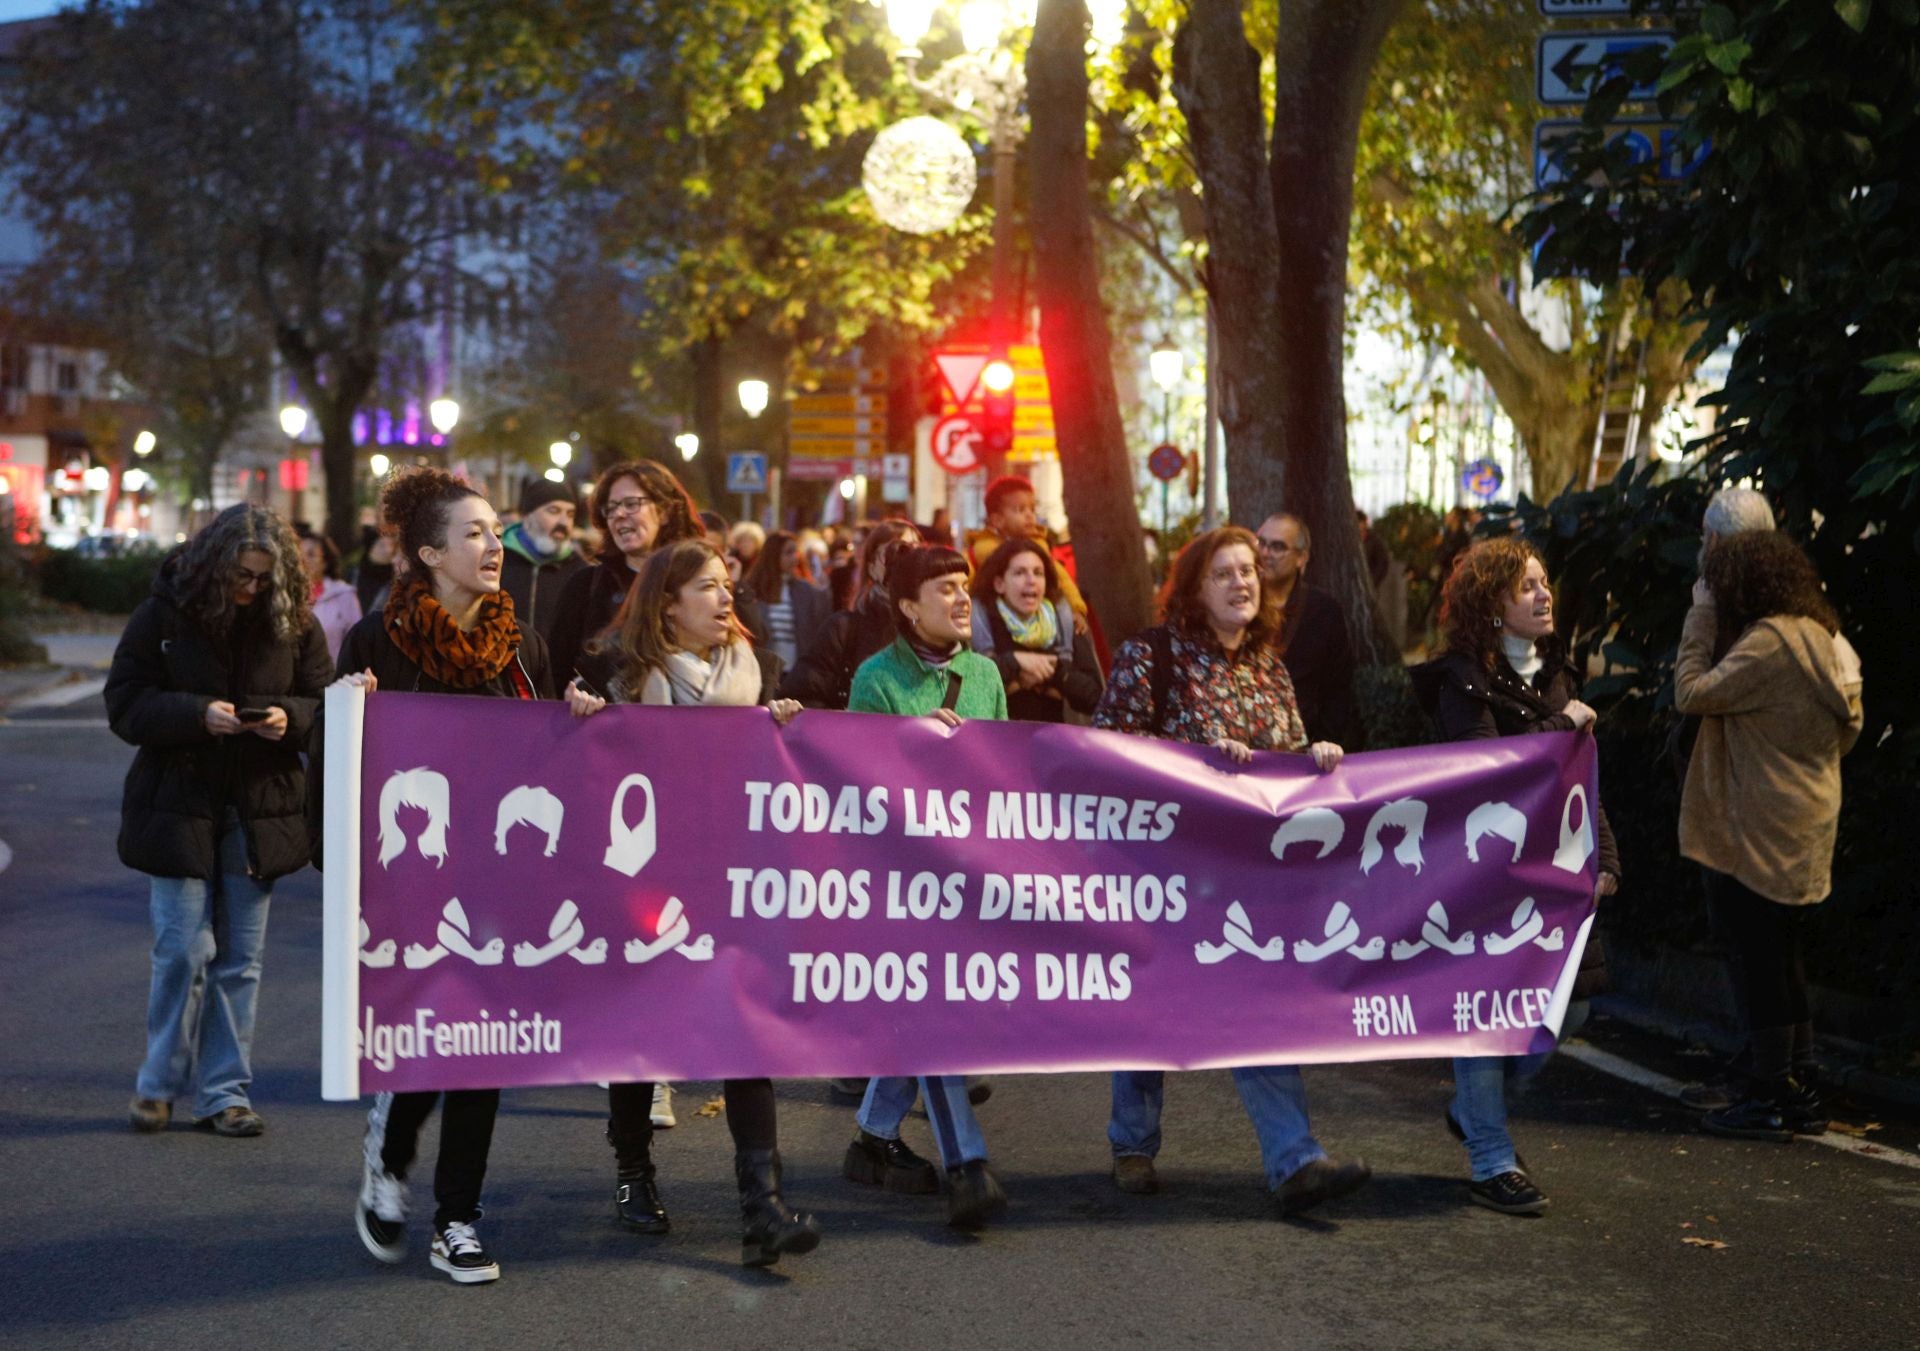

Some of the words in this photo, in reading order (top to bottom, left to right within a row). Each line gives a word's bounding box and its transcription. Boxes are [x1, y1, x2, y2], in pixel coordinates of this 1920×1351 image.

[745, 781, 889, 835] TODAS
[903, 787, 972, 839] LAS
[986, 791, 1181, 842] MUJERES
[726, 867, 871, 920] TODOS
[886, 870, 967, 921] LOS
[979, 873, 1187, 923] DERECHOS
[789, 951, 929, 1003] TODOS
[944, 952, 1021, 1002] LOS
[1036, 952, 1132, 1002] DIAS
[1352, 995, 1418, 1038] #8M
